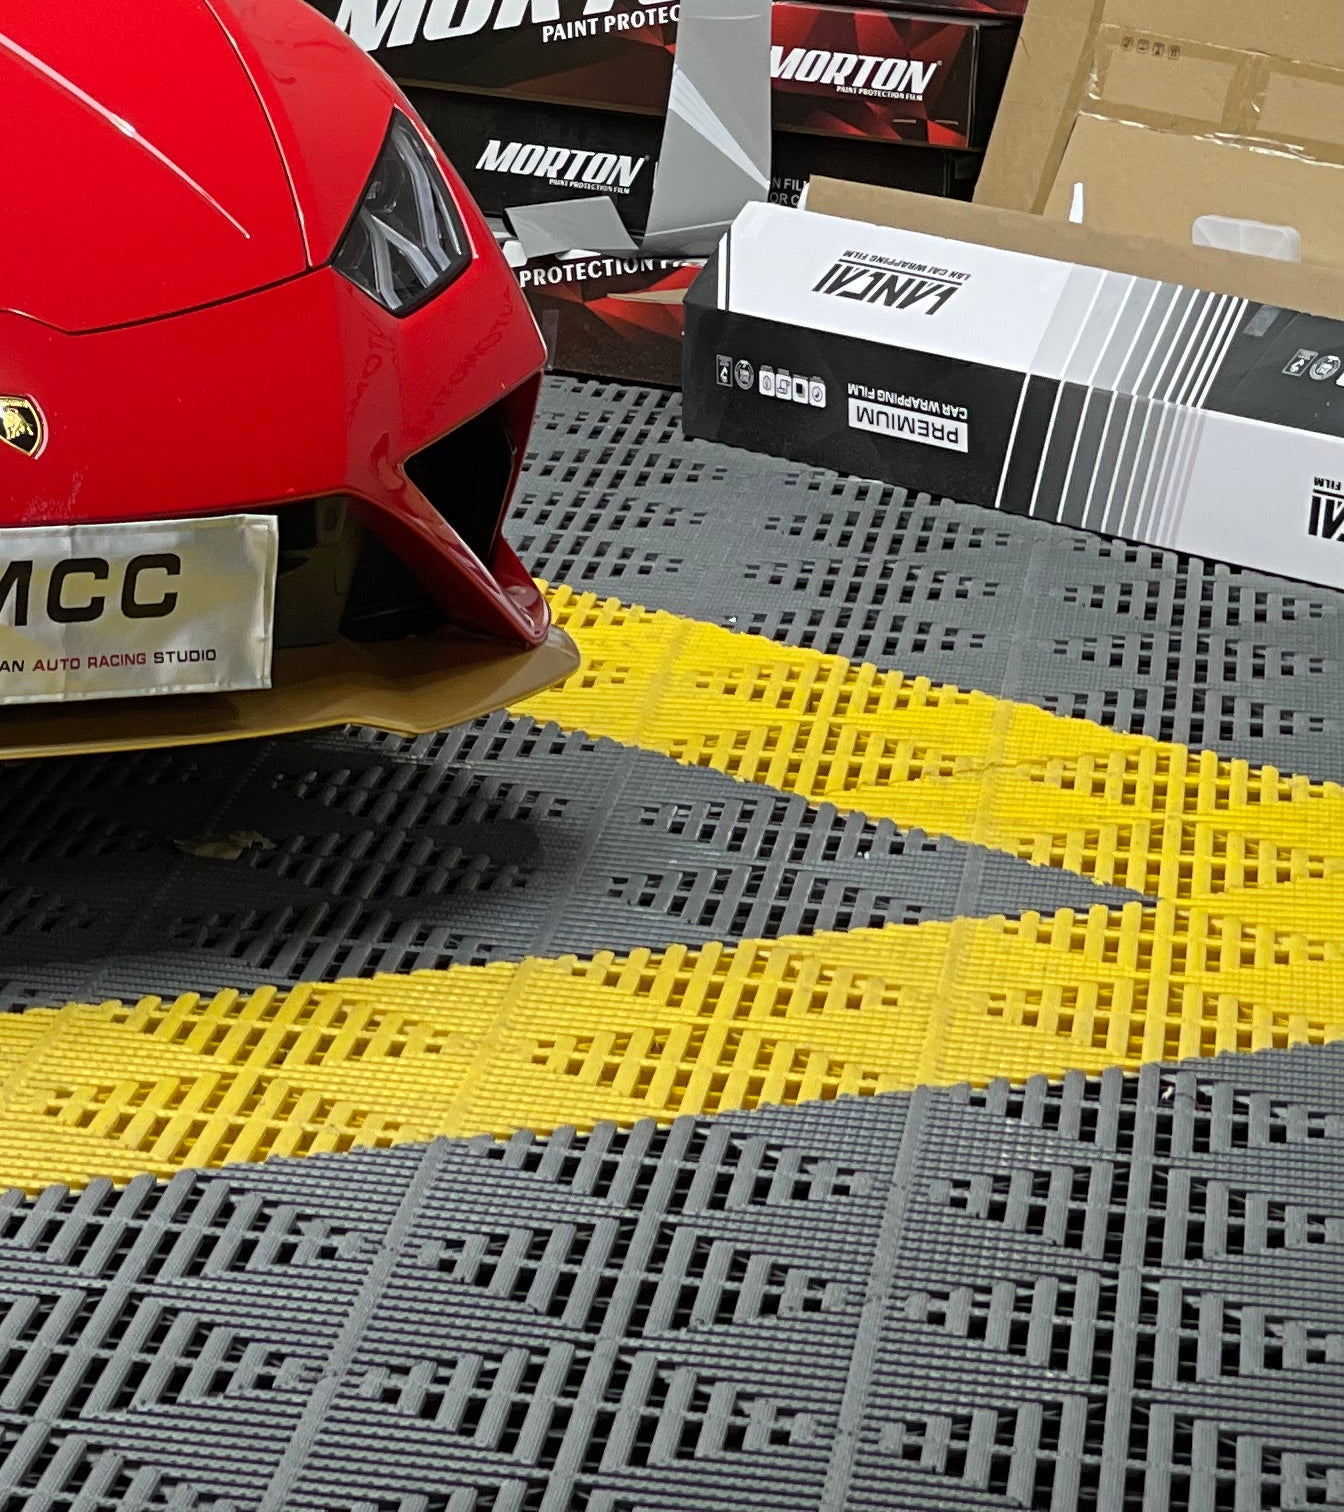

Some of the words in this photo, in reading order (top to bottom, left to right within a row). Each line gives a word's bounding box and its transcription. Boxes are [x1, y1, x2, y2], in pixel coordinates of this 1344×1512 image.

[542, 18, 599, 43] PAINT
[604, 5, 682, 34] PROTEC
[770, 44, 937, 94] MORTON
[475, 139, 645, 188] MORTON
[843, 249, 869, 261] FILM
[870, 254, 927, 273] WRAPPING
[519, 258, 654, 288] PROTECTION
[811, 263, 958, 316] LANCAI
[847, 382, 875, 400] FILM
[877, 388, 941, 414] WRAPPING
[856, 405, 959, 444] PREMIUM
[942, 403, 968, 420] CAR
[1313, 476, 1342, 491] FILM
[31, 656, 81, 673] AUTO
[86, 652, 147, 670] RACING
[153, 647, 217, 665] STUDIO
